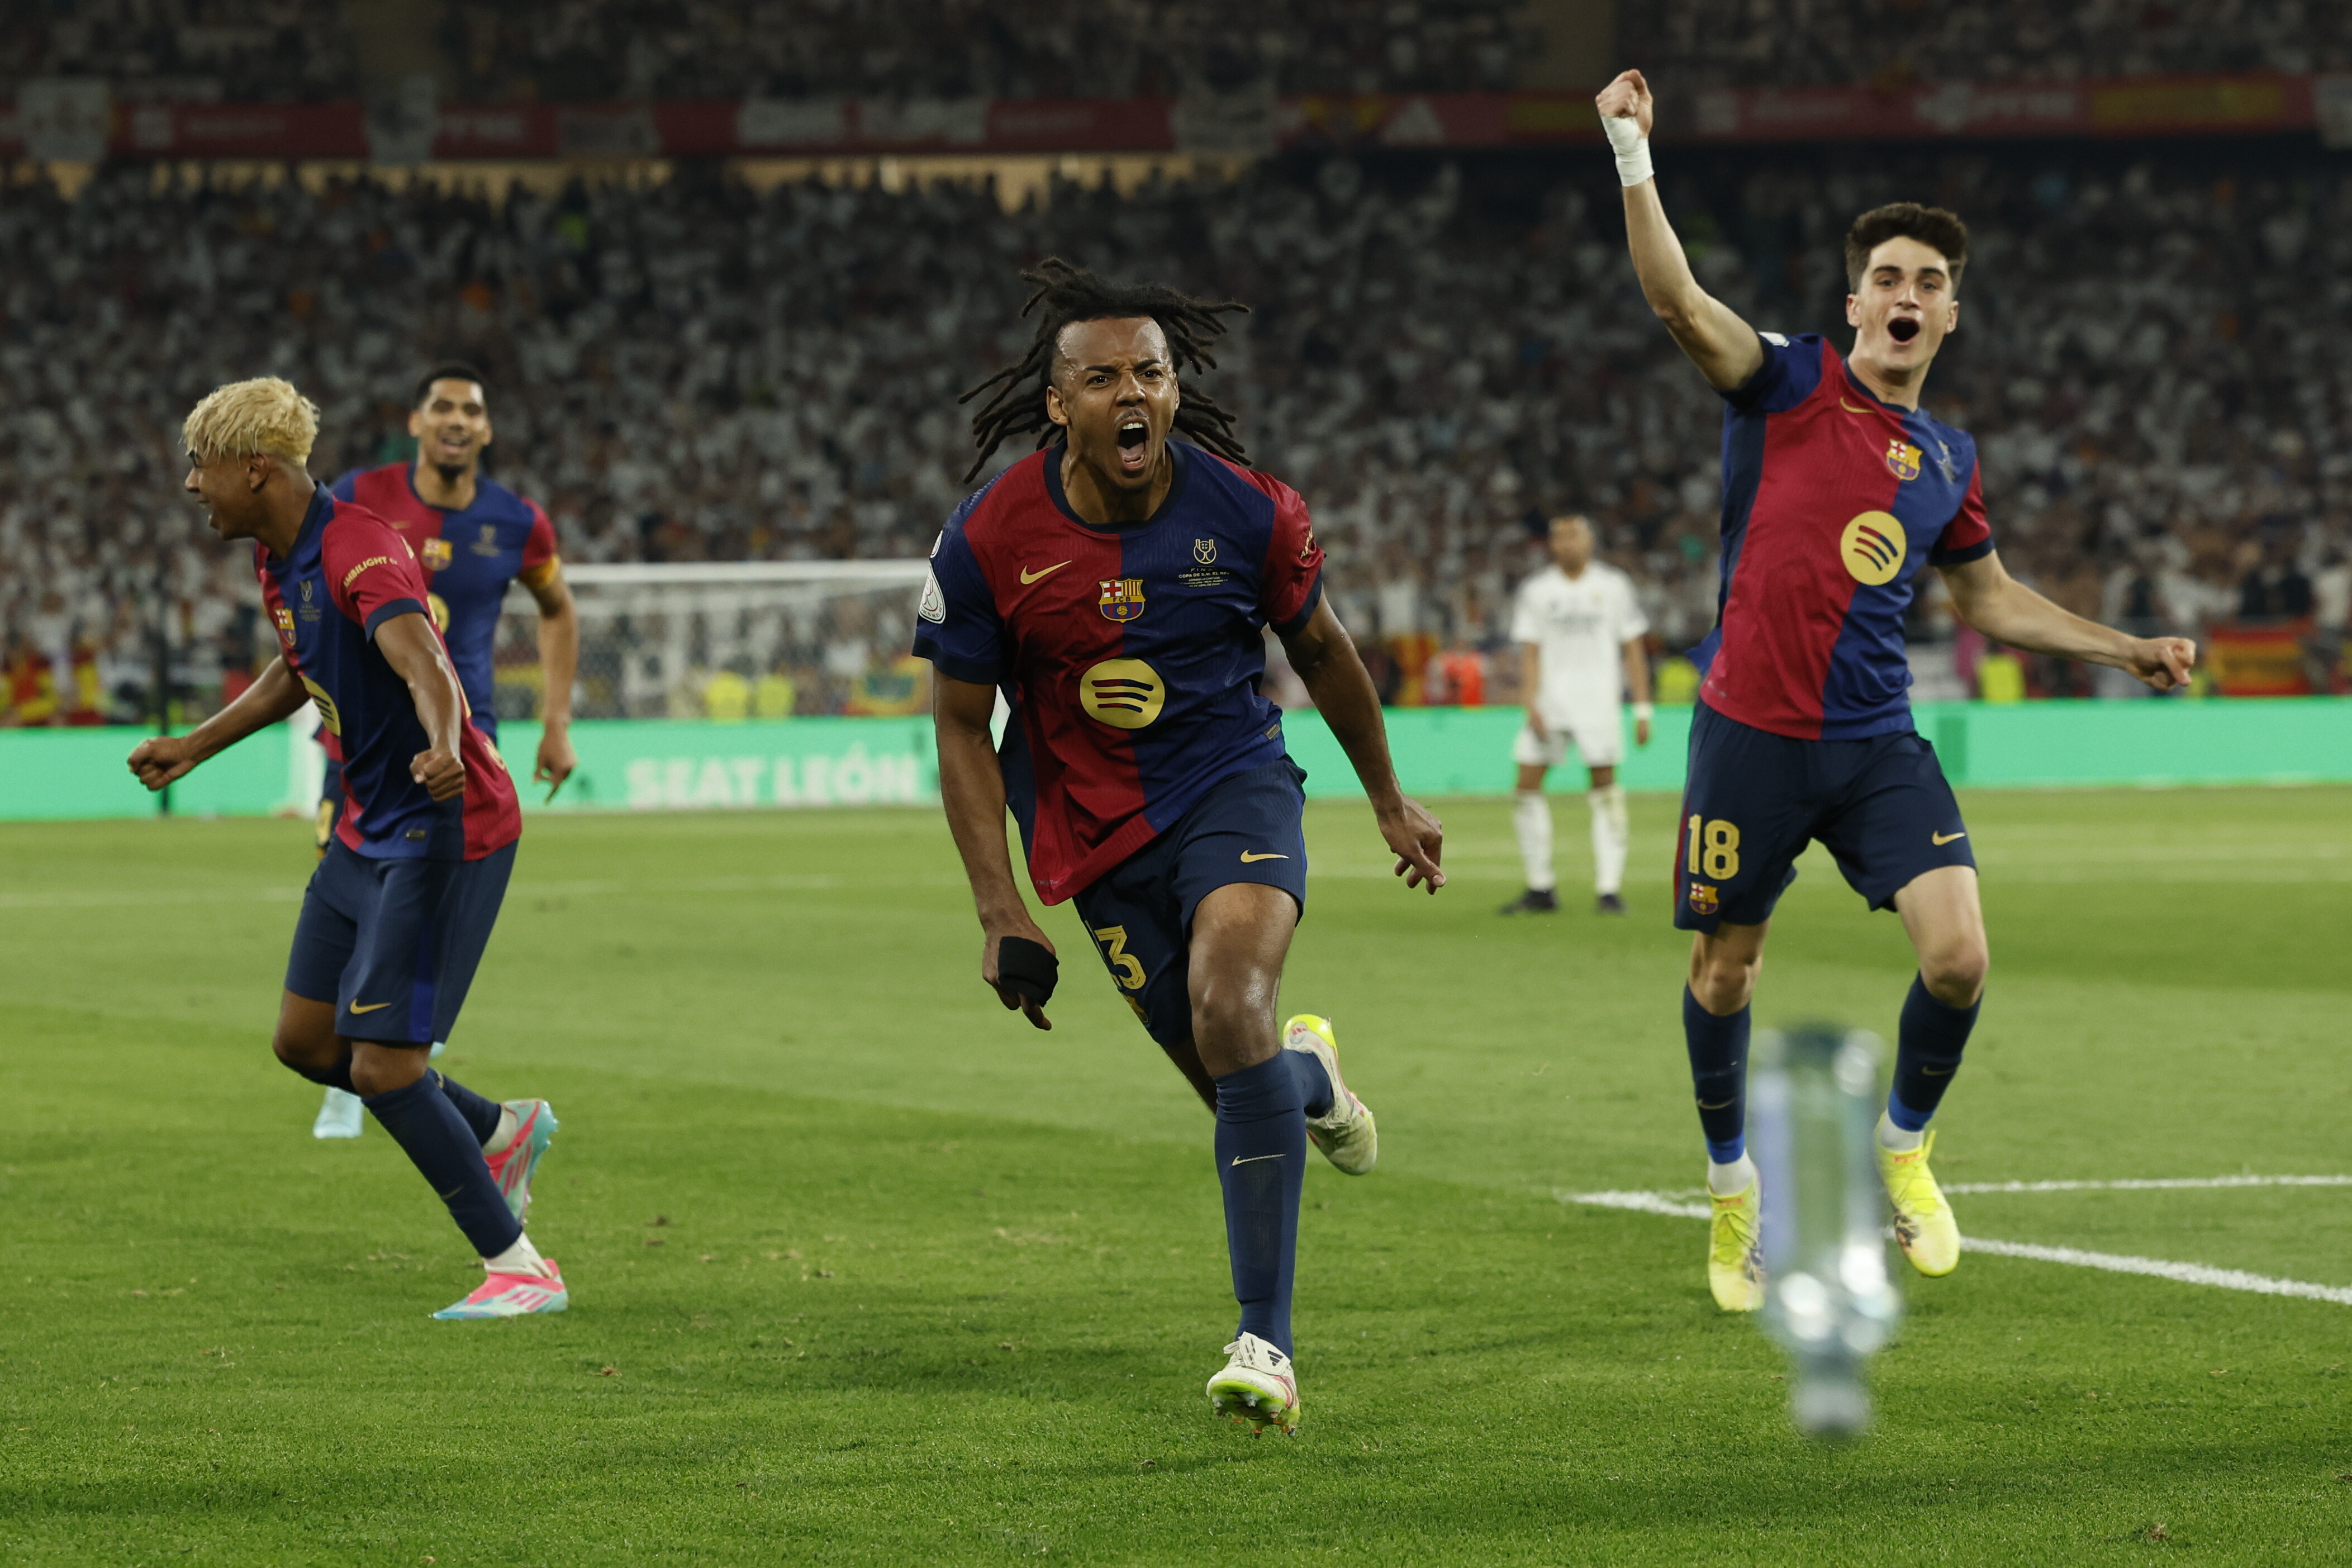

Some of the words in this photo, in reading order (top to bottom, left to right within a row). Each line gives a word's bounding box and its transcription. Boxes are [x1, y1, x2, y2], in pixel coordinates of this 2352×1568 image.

[625, 754, 767, 810] SEAT
[773, 740, 916, 806] LEÓN
[1688, 814, 1741, 881] 18
[1086, 920, 1147, 990] 3
